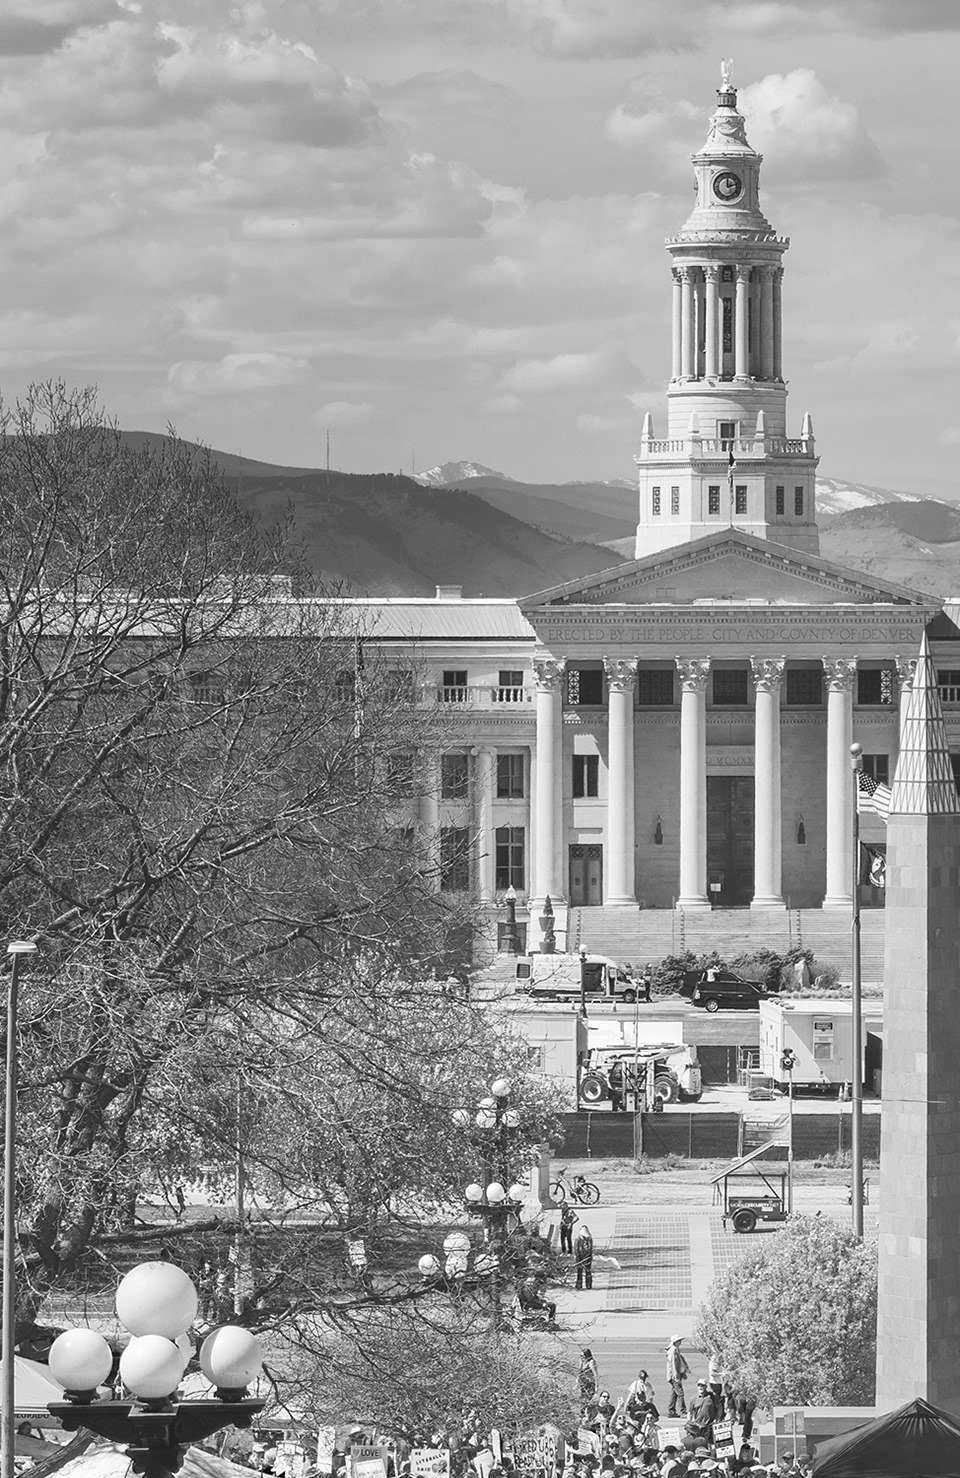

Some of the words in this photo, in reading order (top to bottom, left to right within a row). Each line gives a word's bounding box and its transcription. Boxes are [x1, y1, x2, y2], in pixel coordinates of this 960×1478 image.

[548, 628, 605, 641] ERECTED
[610, 628, 625, 641] BY
[630, 628, 654, 641] THE
[660, 628, 705, 641] PEOPLE
[712, 628, 740, 641] CITY
[747, 628, 775, 641] AND
[780, 628, 830, 641] COVNTY
[840, 628, 858, 641] OF
[862, 628, 915, 641] DENVER
